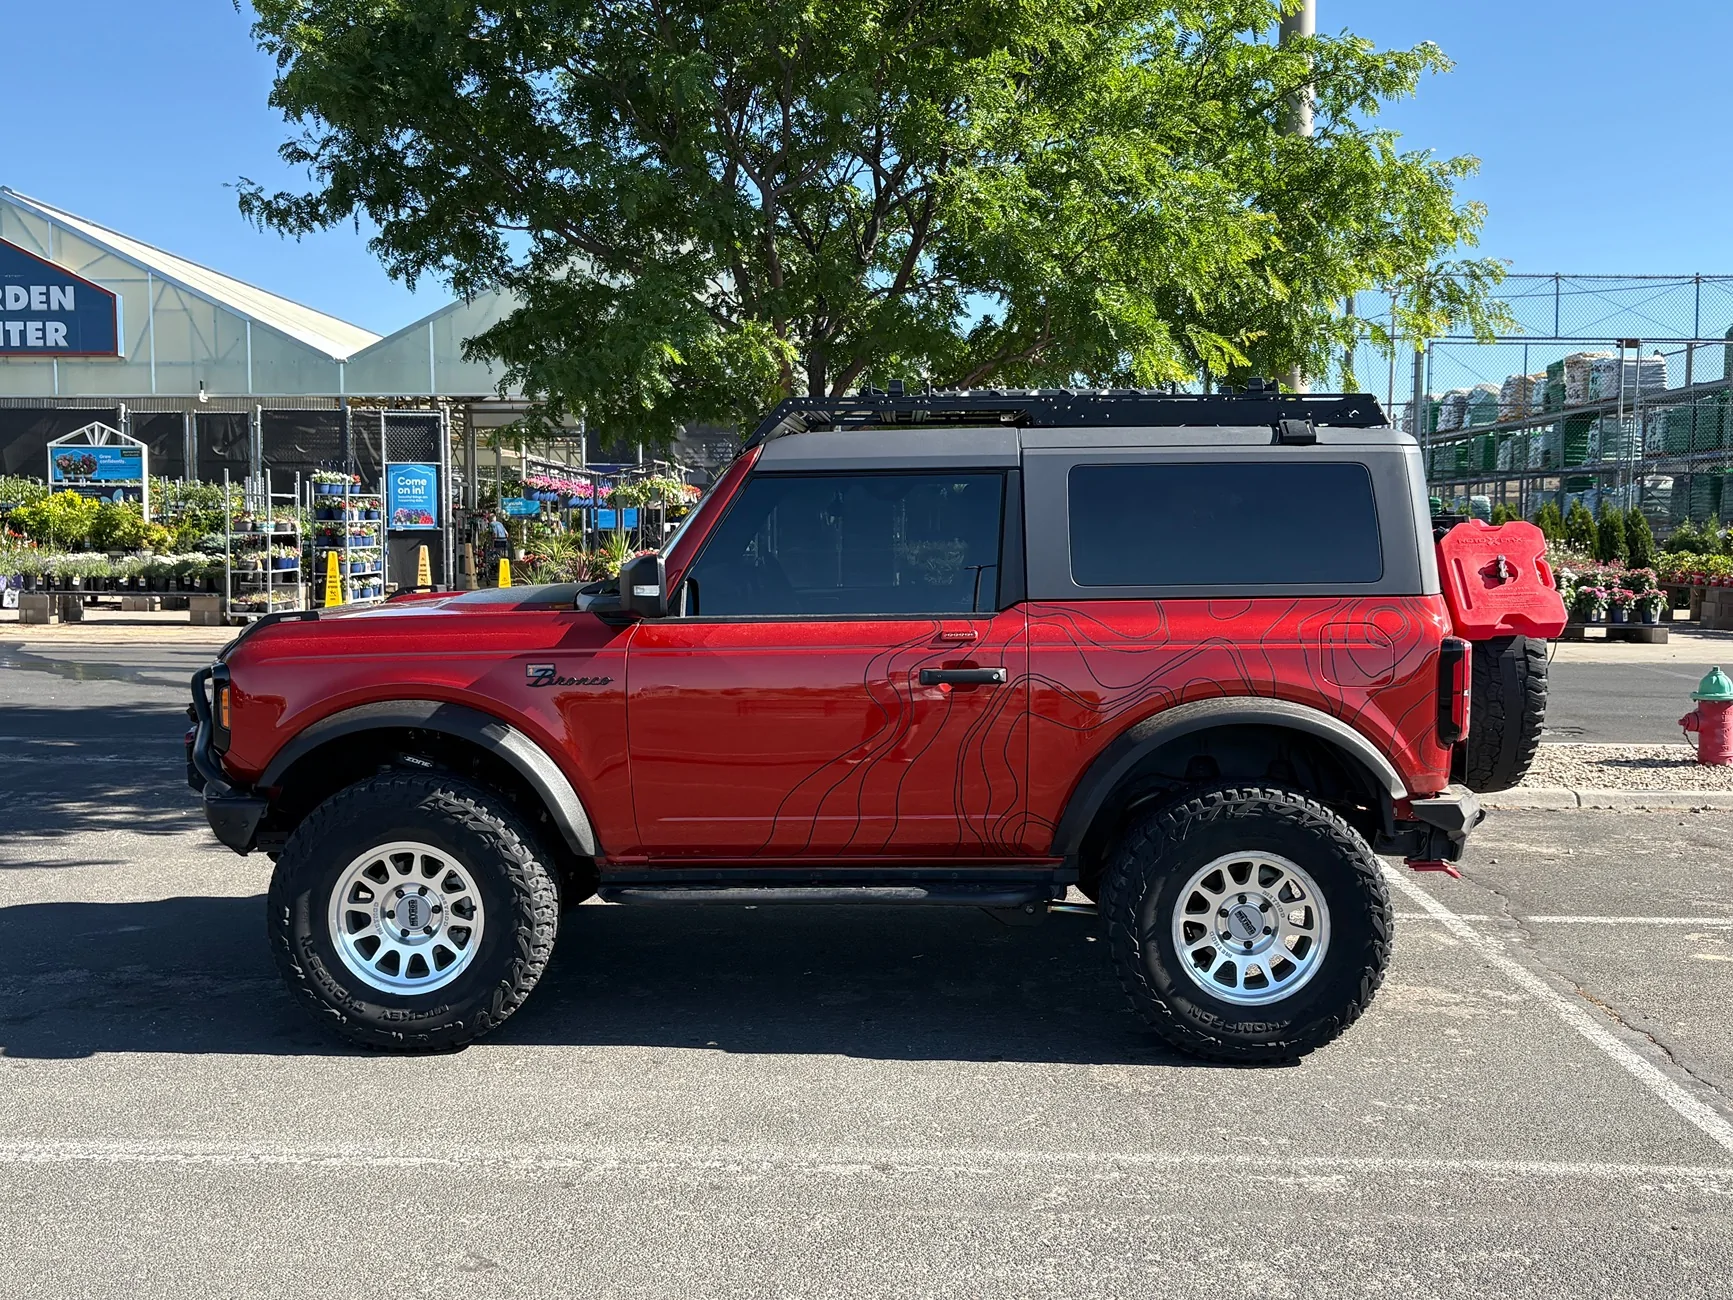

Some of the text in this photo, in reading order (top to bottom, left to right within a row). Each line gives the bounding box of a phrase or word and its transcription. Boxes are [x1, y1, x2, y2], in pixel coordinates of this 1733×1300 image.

[0, 285, 75, 311] DEN
[0, 321, 69, 347] TER
[397, 477, 427, 485] Come
[412, 486, 424, 494] in!
[526, 668, 614, 688] Bronco
[408, 899, 417, 926] METHOD
[1235, 910, 1257, 935] METHOD
